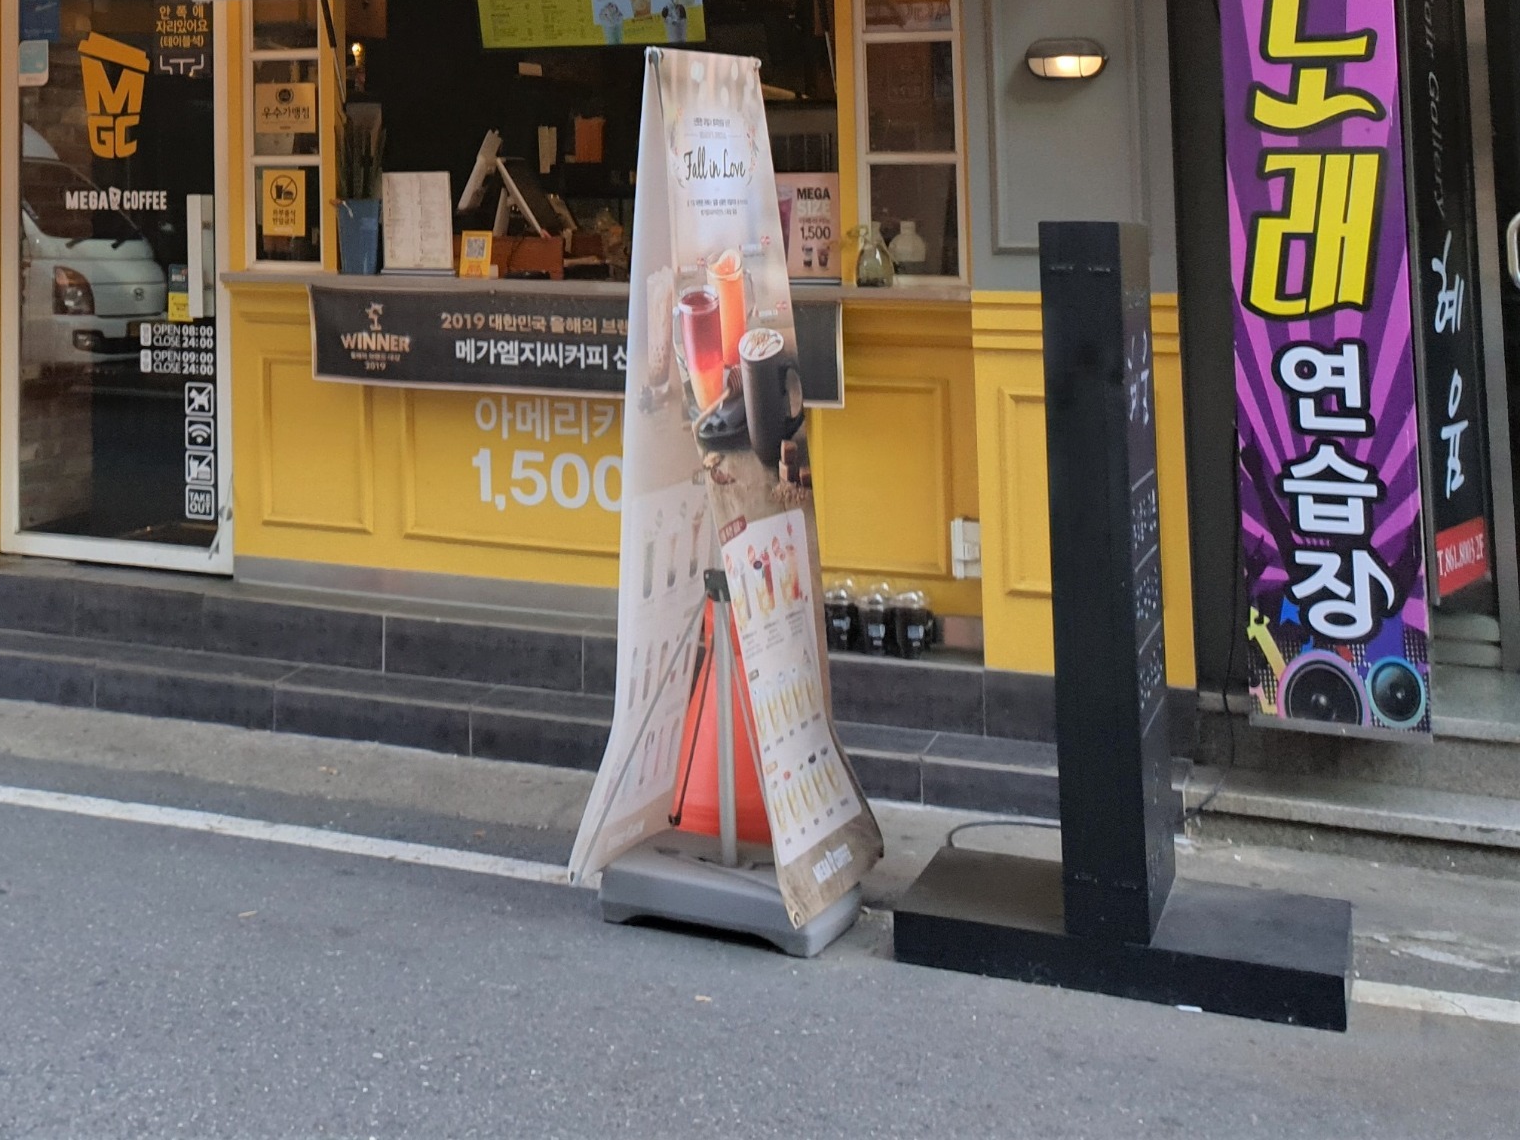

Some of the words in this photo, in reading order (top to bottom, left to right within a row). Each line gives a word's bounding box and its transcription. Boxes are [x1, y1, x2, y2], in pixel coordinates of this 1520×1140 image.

[683, 146, 708, 181] Fall
[709, 158, 721, 179] in
[723, 148, 746, 179] Love
[66, 190, 108, 210] MEGA
[123, 191, 167, 210] COFFEE
[796, 187, 831, 200] MEGA
[800, 226, 831, 241] 1,500
[441, 311, 485, 330] 2019
[488, 313, 546, 334] 대한민국
[153, 324, 180, 336] OPEN
[182, 325, 213, 337] 08:00
[153, 335, 180, 348] CLOSE
[182, 337, 213, 349] 24:00
[341, 332, 410, 352] WINNER
[153, 350, 180, 362] OPEN
[455, 337, 608, 371] 메가엠지씨커피
[153, 361, 180, 374] CLOSE
[182, 363, 213, 375] 24:00
[189, 491, 211, 503] TAKE
[189, 502, 211, 514] OUT
